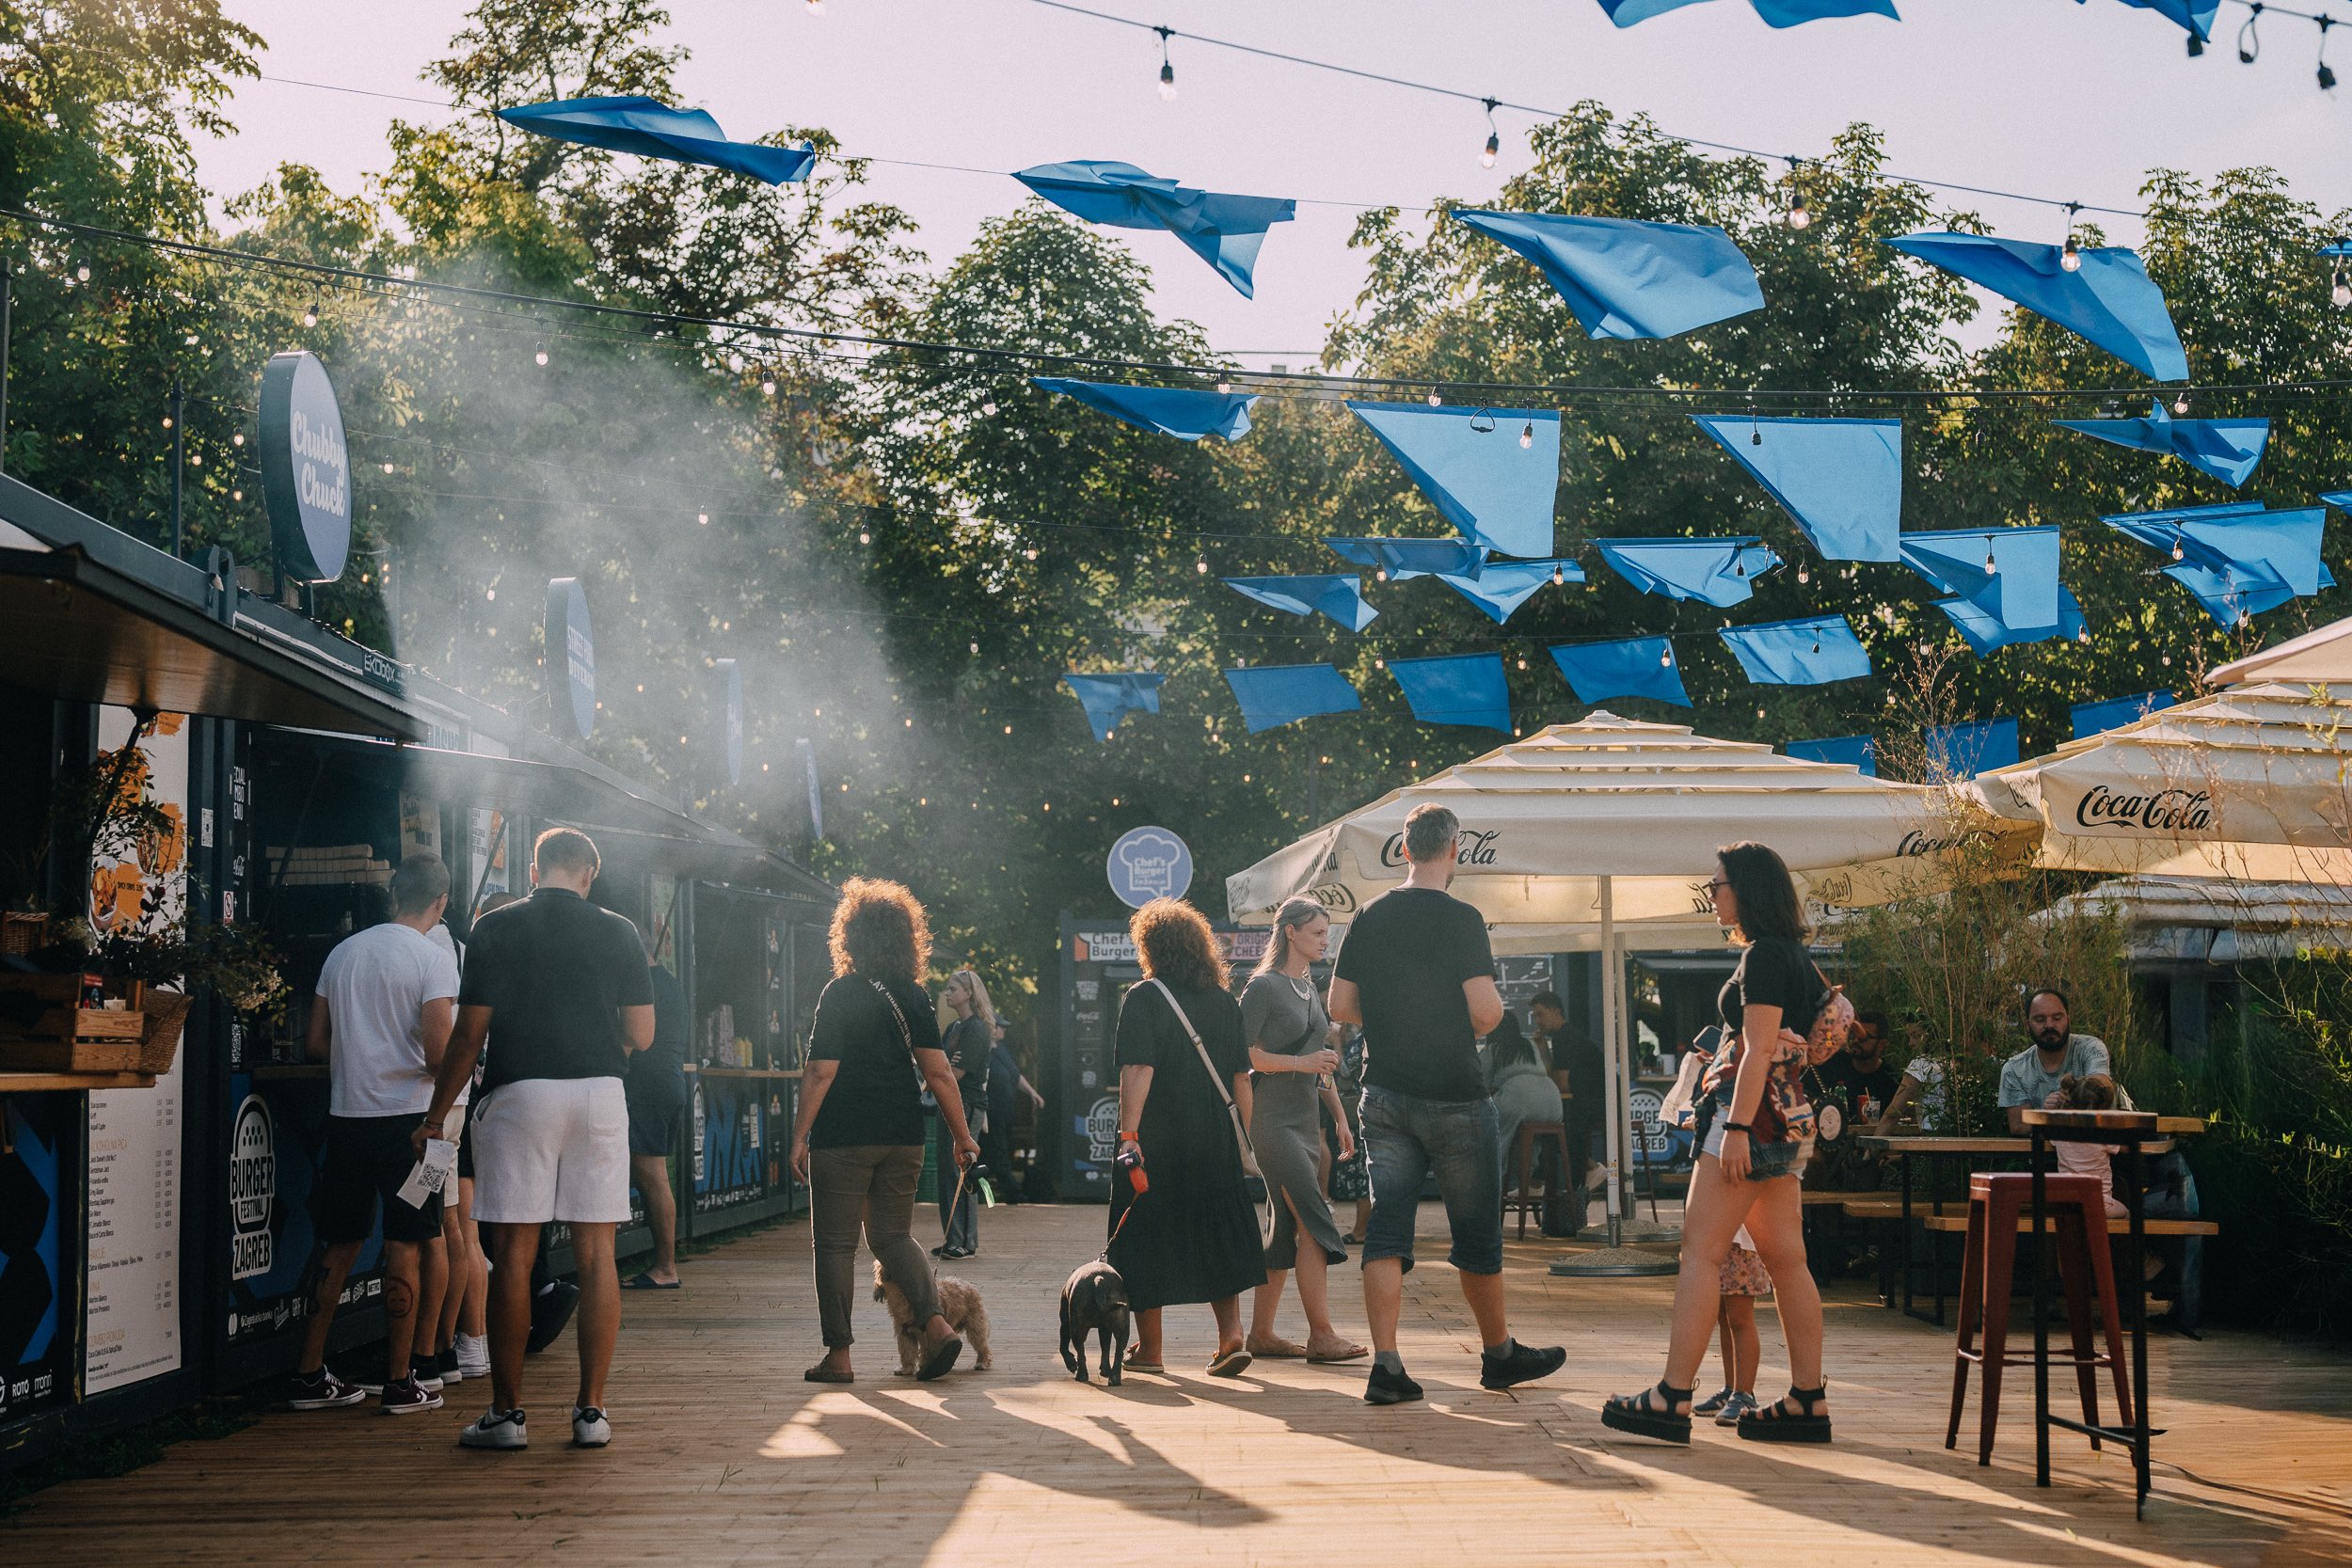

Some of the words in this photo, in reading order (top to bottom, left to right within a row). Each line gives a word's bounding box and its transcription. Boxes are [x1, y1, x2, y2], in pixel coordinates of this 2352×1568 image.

[293, 410, 347, 488] Chubby
[301, 462, 345, 517] Chuck
[2076, 784, 2211, 831] Coca-Cola
[1134, 857, 1167, 867] Chef's
[1092, 946, 1136, 960] Burger
[1088, 1118, 1115, 1132] BUR
[1092, 1147, 1113, 1159] ZAG
[231, 1155, 274, 1200] BURGER
[241, 1199, 264, 1220] FESTIVAL
[234, 1233, 270, 1275] ZAGREB
